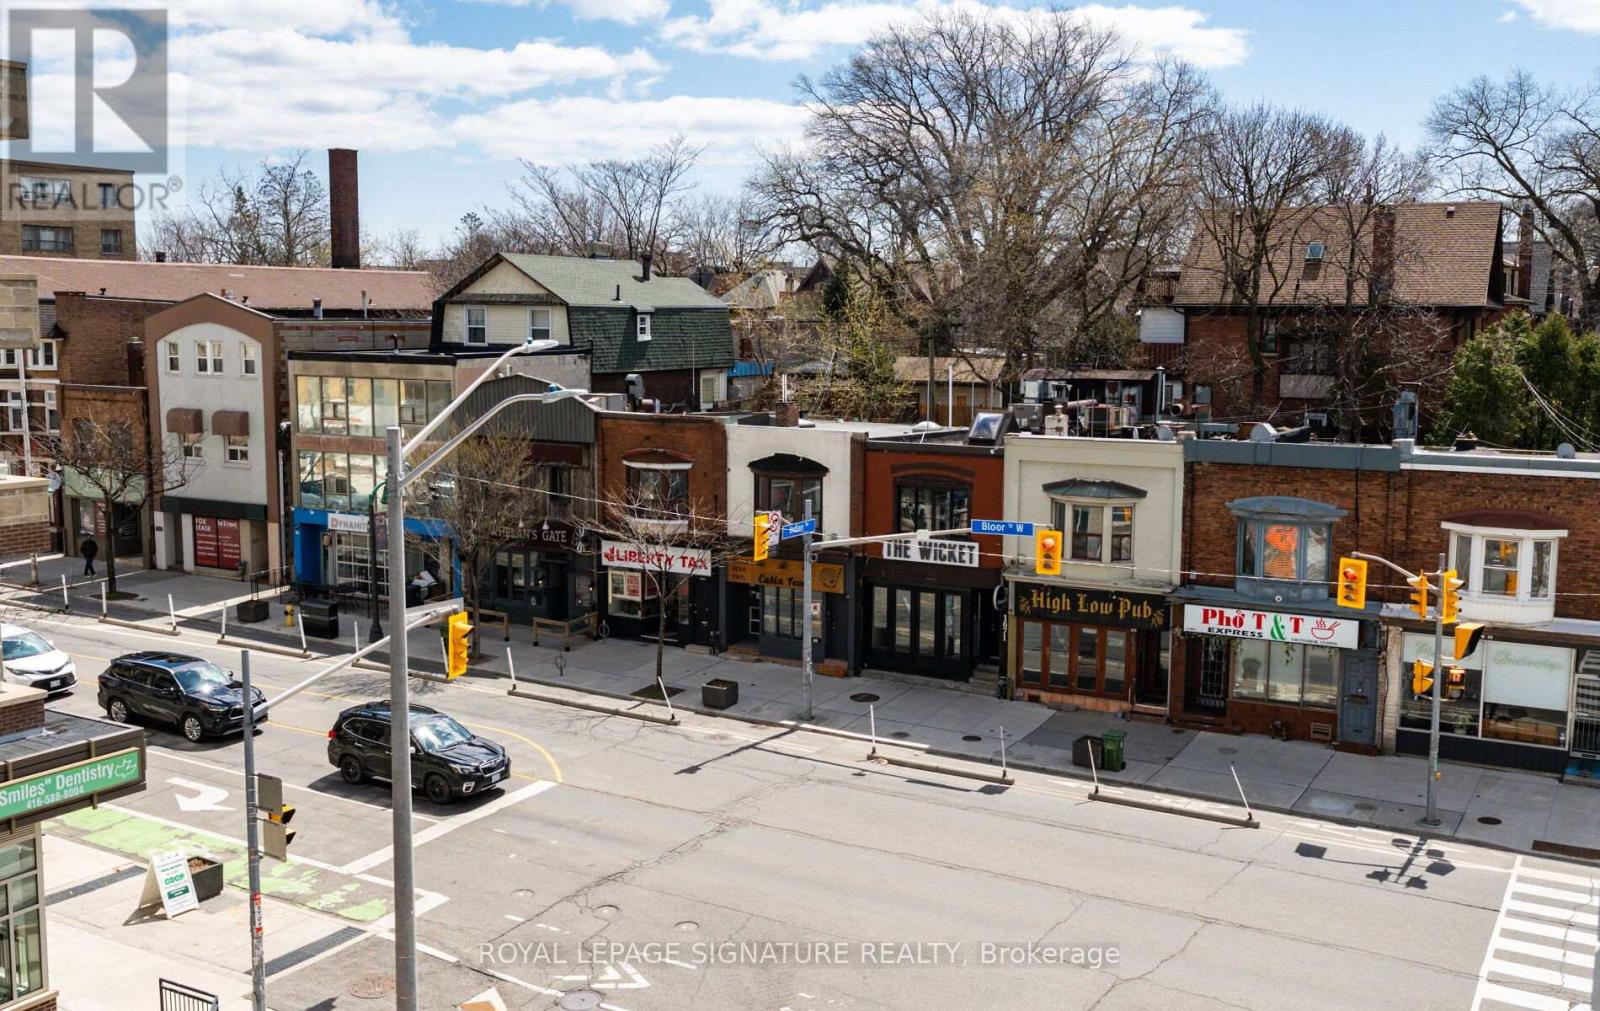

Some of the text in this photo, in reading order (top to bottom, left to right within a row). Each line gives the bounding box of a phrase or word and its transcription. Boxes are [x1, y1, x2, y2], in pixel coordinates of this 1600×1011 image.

[542, 530, 567, 542] GATE
[981, 521, 1006, 532] Bloor
[1016, 524, 1024, 533] W
[680, 554, 708, 570] TAX
[886, 539, 976, 565] THE WICKET
[1030, 589, 1152, 620] High Low Pub
[1207, 626, 1264, 638] EXPRESS
[1252, 612, 1267, 630] T
[1270, 614, 1287, 641] &
[1289, 616, 1304, 634] T
[56, 762, 115, 790] Dentistry
